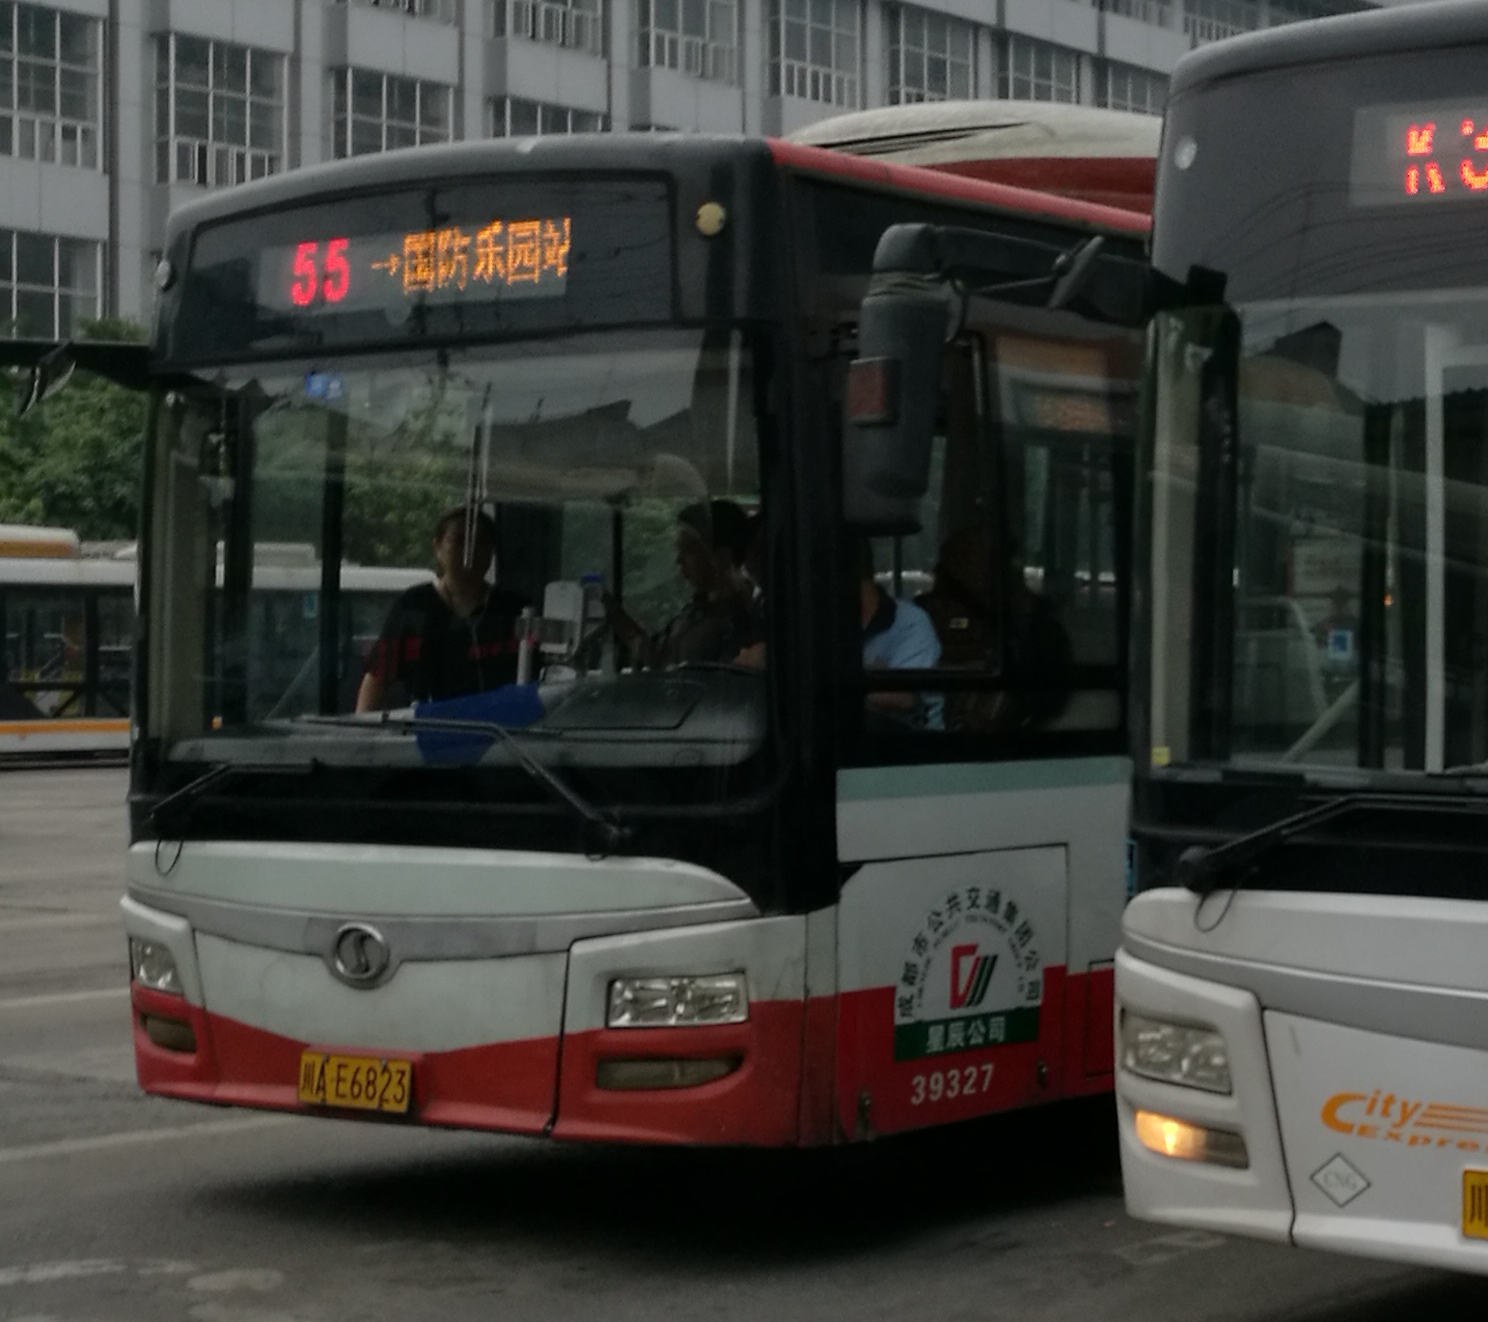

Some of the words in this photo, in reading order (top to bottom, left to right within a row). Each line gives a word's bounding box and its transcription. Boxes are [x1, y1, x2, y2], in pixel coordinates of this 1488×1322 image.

[290, 237, 351, 307] 55
[910, 1063, 995, 1106] 39327
[1320, 1088, 1422, 1135] City
